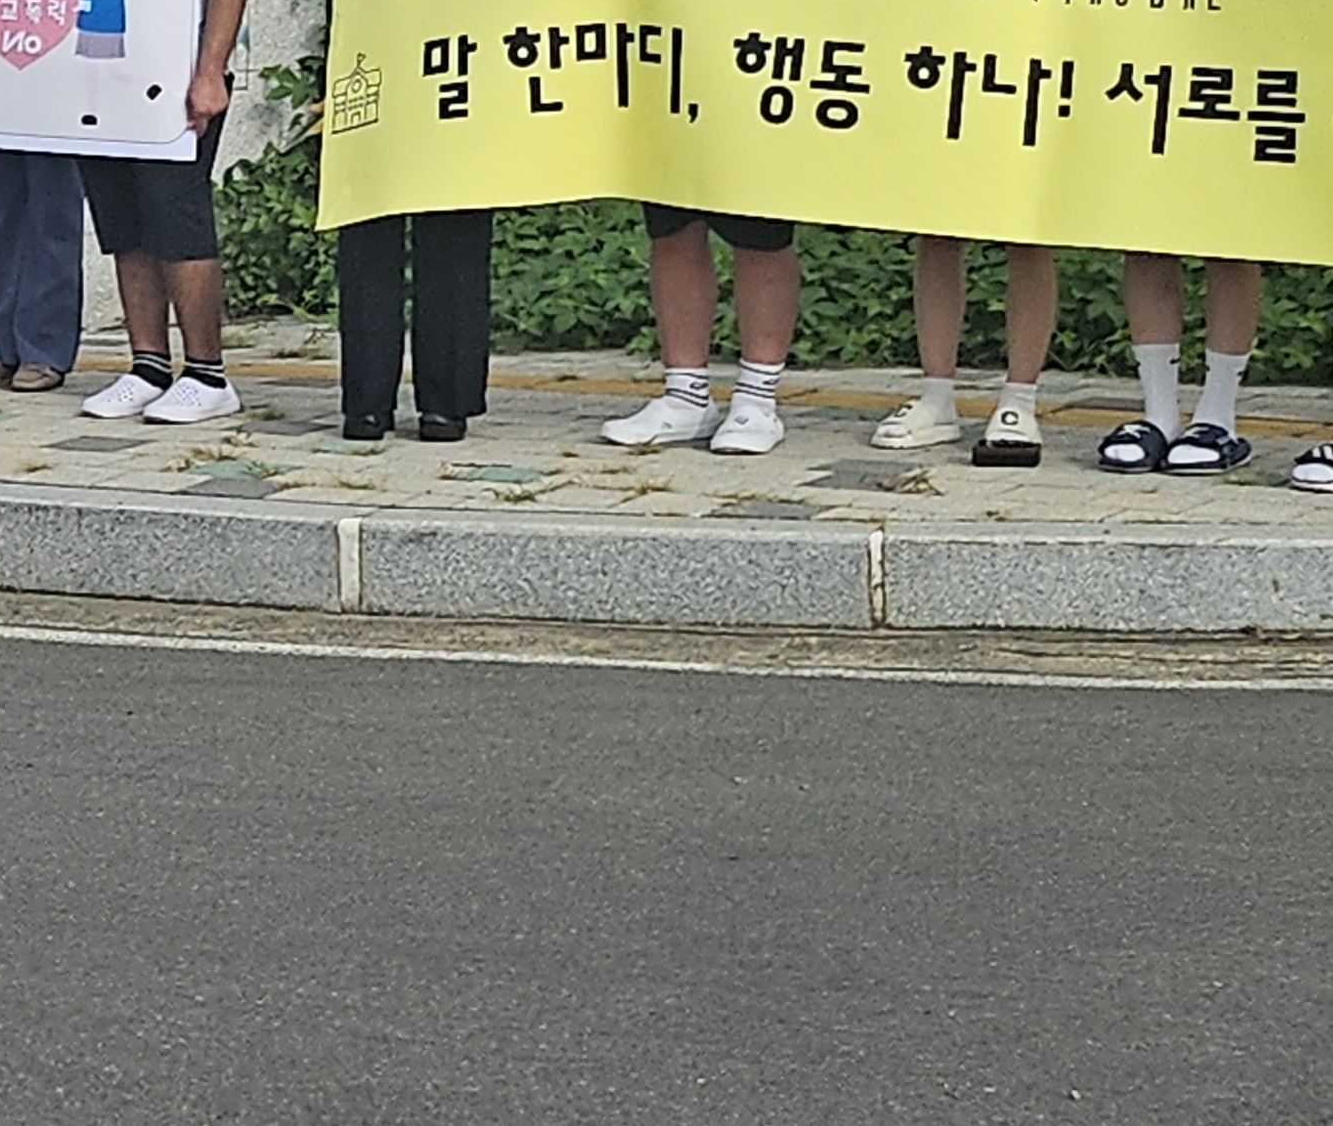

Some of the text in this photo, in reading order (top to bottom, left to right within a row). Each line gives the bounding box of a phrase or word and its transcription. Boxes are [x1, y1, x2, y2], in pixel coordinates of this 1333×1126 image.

[423, 23, 1306, 164] 말 한마디, 행동 하나! 서로를
